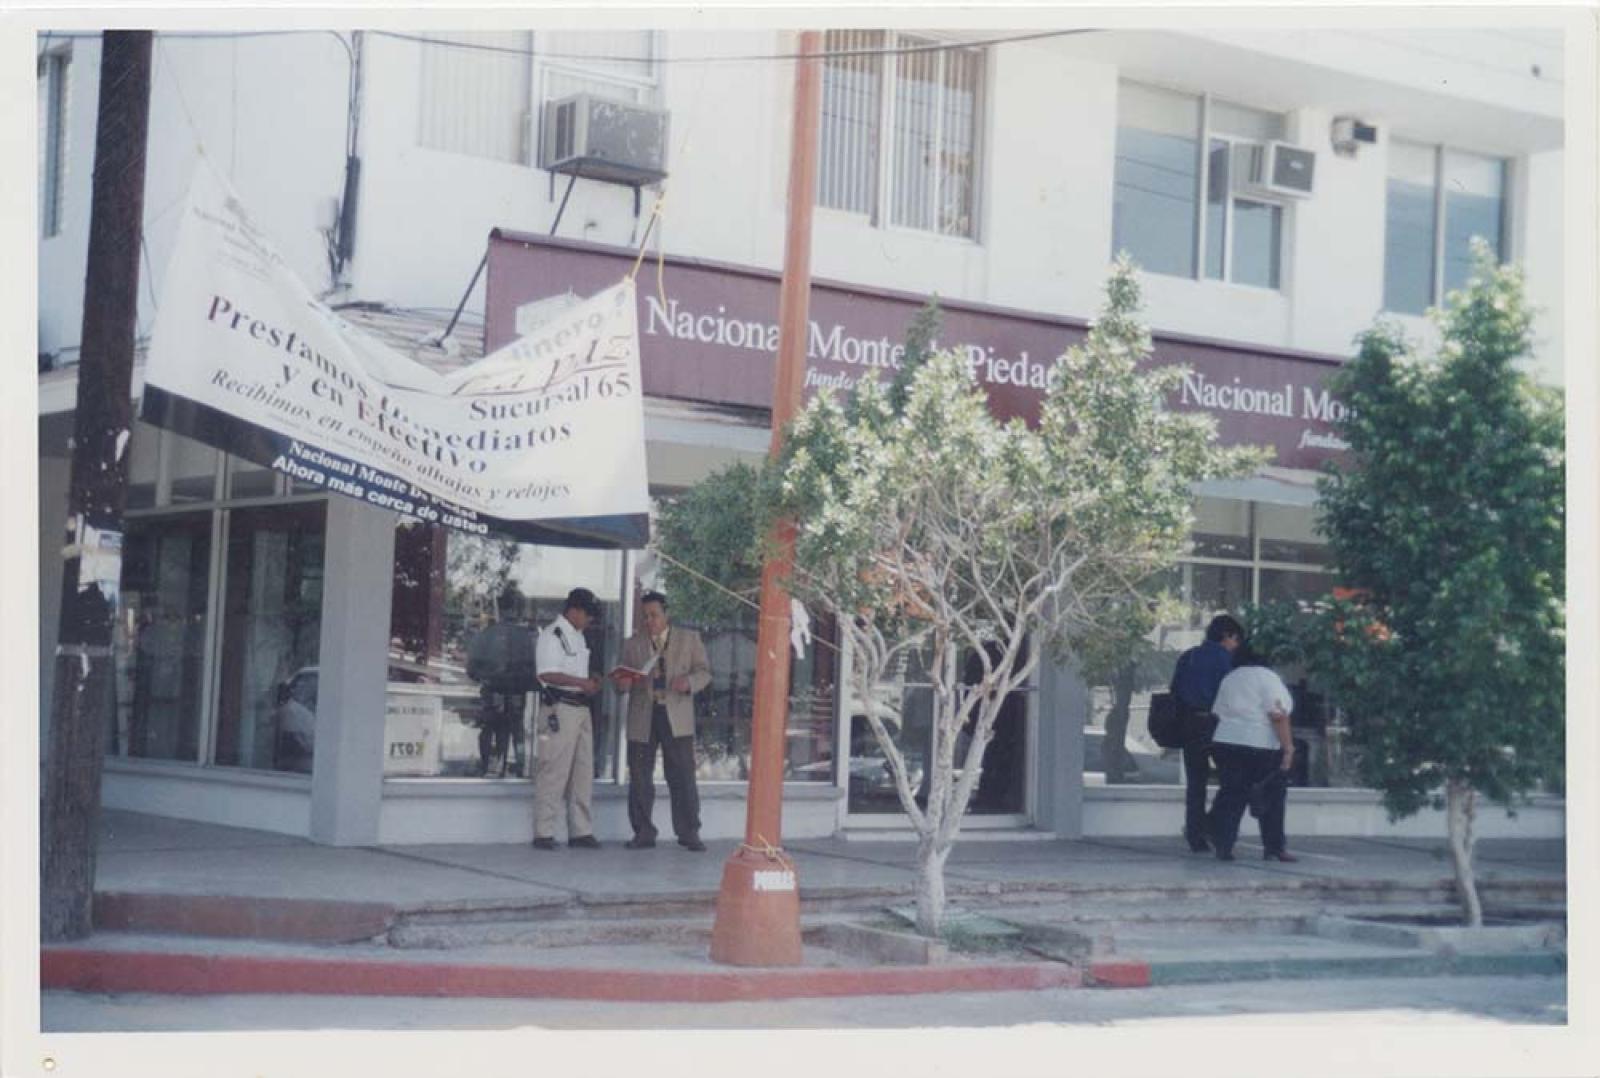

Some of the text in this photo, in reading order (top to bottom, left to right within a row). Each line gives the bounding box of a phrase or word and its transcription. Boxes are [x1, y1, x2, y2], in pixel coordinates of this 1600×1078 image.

[207, 294, 370, 400] Prestamos
[645, 295, 782, 351] Naciona
[807, 321, 907, 371] Monte
[275, 363, 300, 390] y
[311, 377, 344, 407] en
[358, 400, 487, 474] Efectivo
[468, 375, 590, 422] Sucursal
[597, 371, 632, 398] 65
[1180, 372, 1294, 417] Nacional
[210, 368, 313, 420] Recibimos
[317, 414, 344, 433] en
[505, 480, 571, 504] relojes
[288, 440, 356, 476] Nacional
[358, 464, 407, 492] Monte
[272, 455, 324, 485] Ahora
[326, 472, 364, 499] más
[366, 487, 415, 514] cerca
